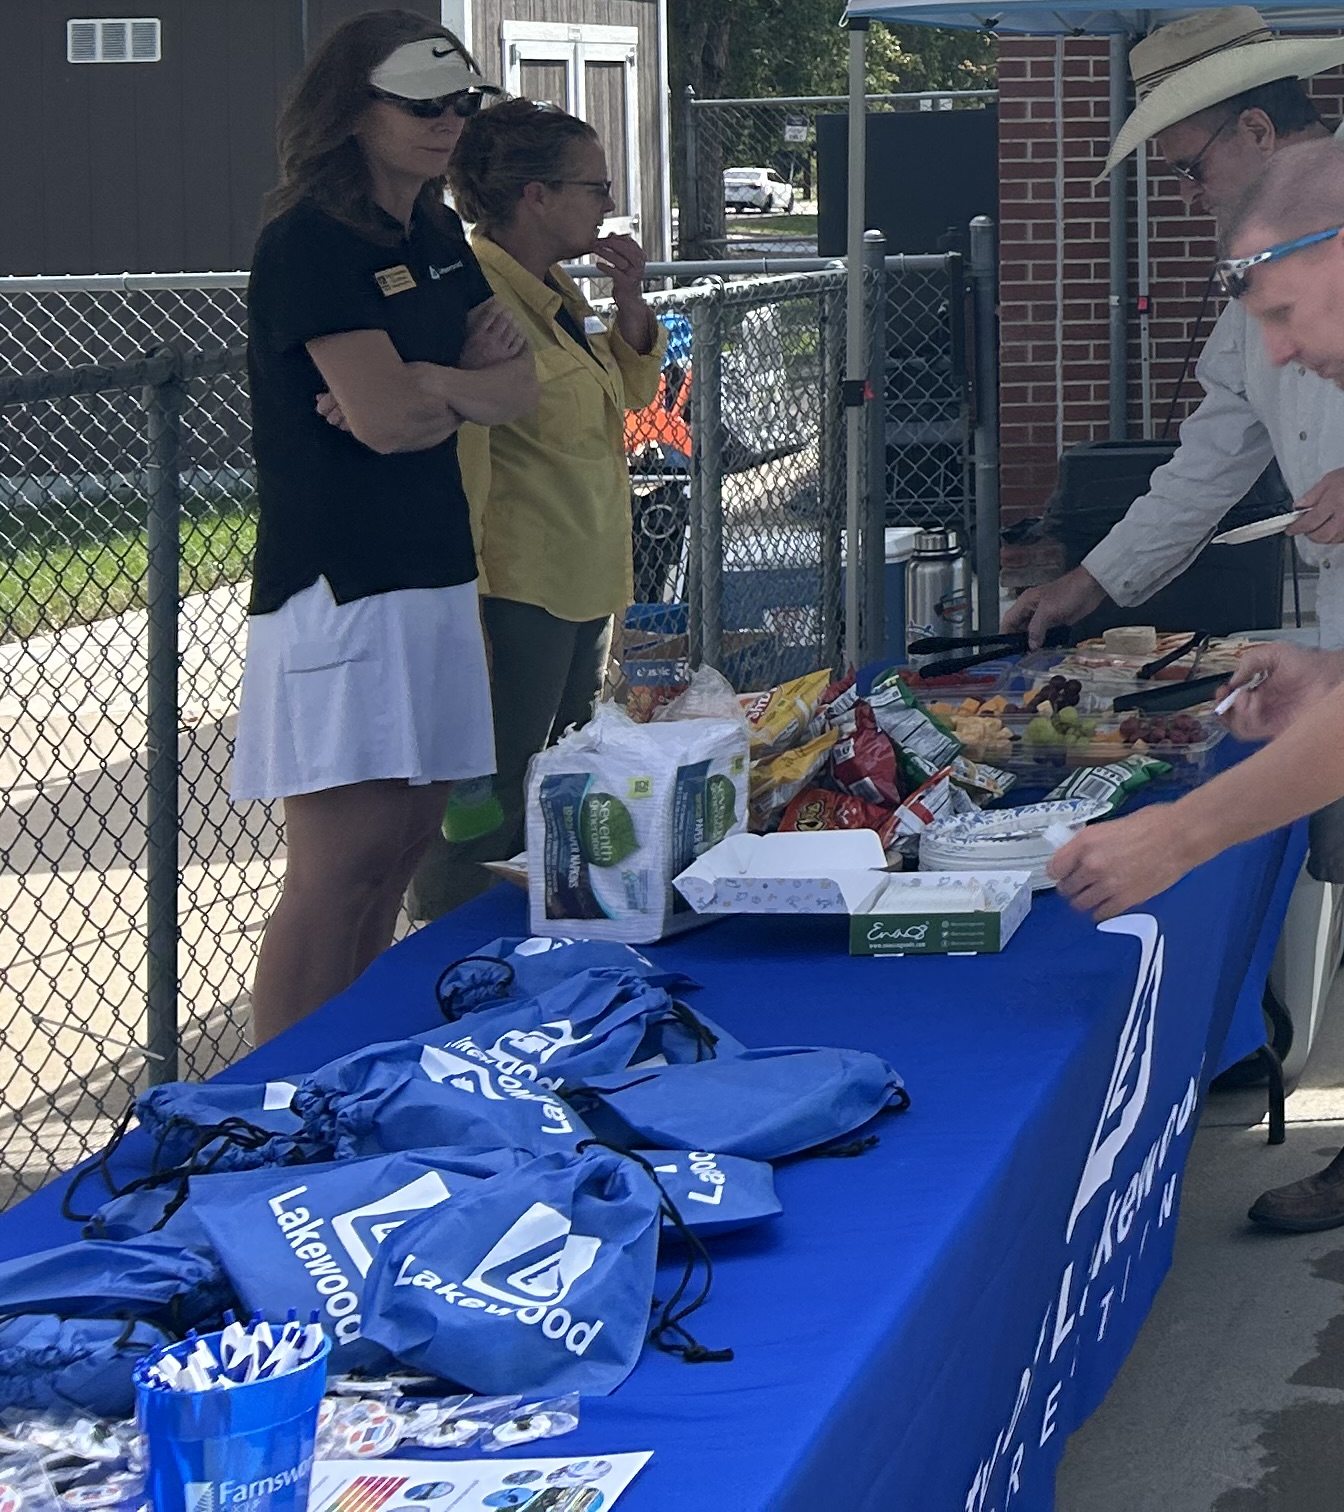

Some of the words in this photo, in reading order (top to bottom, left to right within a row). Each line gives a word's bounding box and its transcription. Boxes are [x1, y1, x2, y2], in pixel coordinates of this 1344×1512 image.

[588, 798, 601, 861] generation
[568, 853, 582, 888] NAPKINS
[393, 1254, 604, 1357] Lakewood
[219, 1454, 315, 1505] Farnswo
